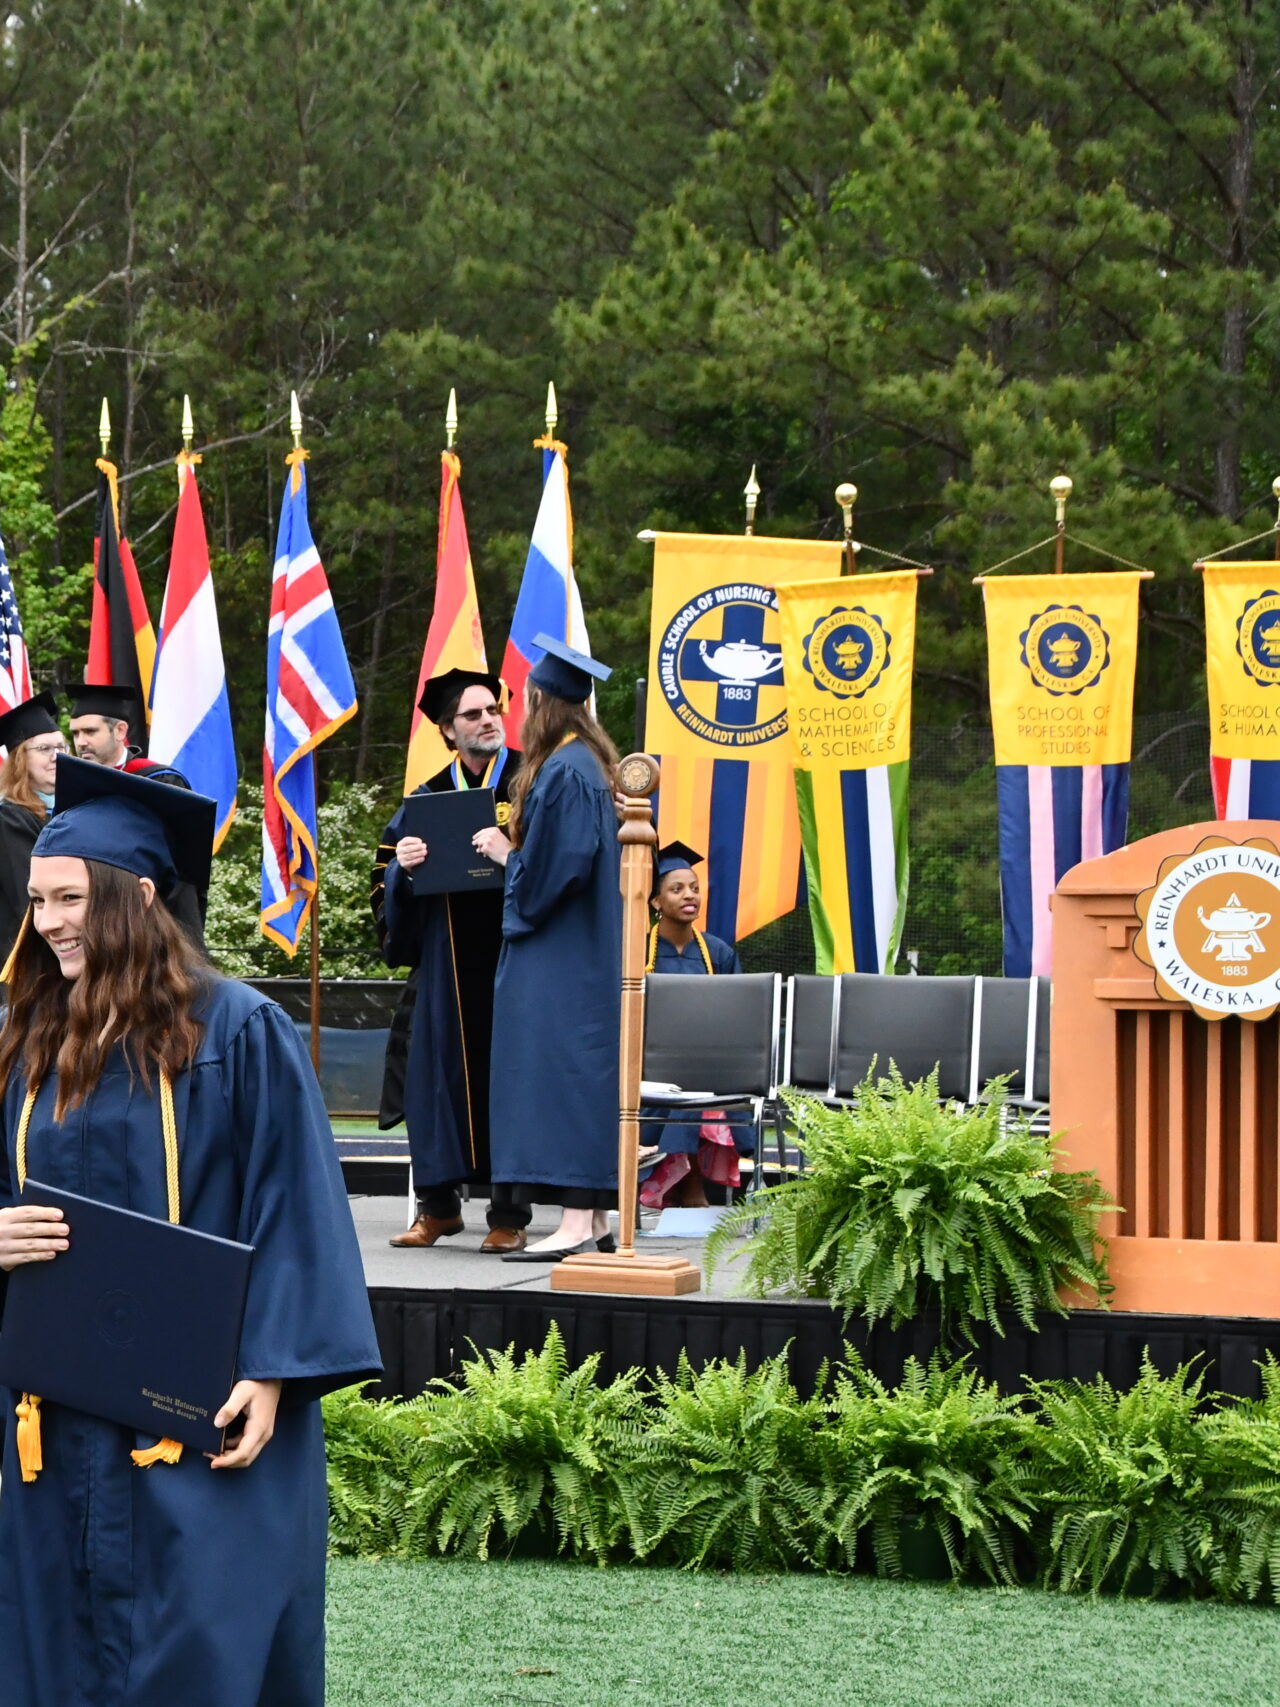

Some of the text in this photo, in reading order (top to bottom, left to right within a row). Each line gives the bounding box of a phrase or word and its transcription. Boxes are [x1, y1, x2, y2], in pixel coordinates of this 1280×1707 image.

[697, 593, 714, 611] OF
[715, 585, 771, 604] NURSING
[665, 605, 700, 650] SCHOOL
[662, 652, 679, 699] CAUBLE
[1247, 654, 1280, 679] WALESK
[722, 687, 752, 701] 1883
[798, 705, 868, 722] SCHOOL
[1017, 704, 1111, 721] SCHOOL OF
[1220, 704, 1270, 719] SCHOOL
[676, 702, 735, 744] REINHARDT
[799, 717, 896, 738] MATHEMATICS
[1018, 724, 1109, 738] PROFESSIONAL
[1219, 721, 1229, 735] &
[800, 735, 896, 757] & SCIENCES
[1041, 741, 1091, 755] STUDIES
[1155, 853, 1228, 931] REINHARDT
[1221, 965, 1248, 977] 1883
[1165, 959, 1263, 1006] WALESKA,
